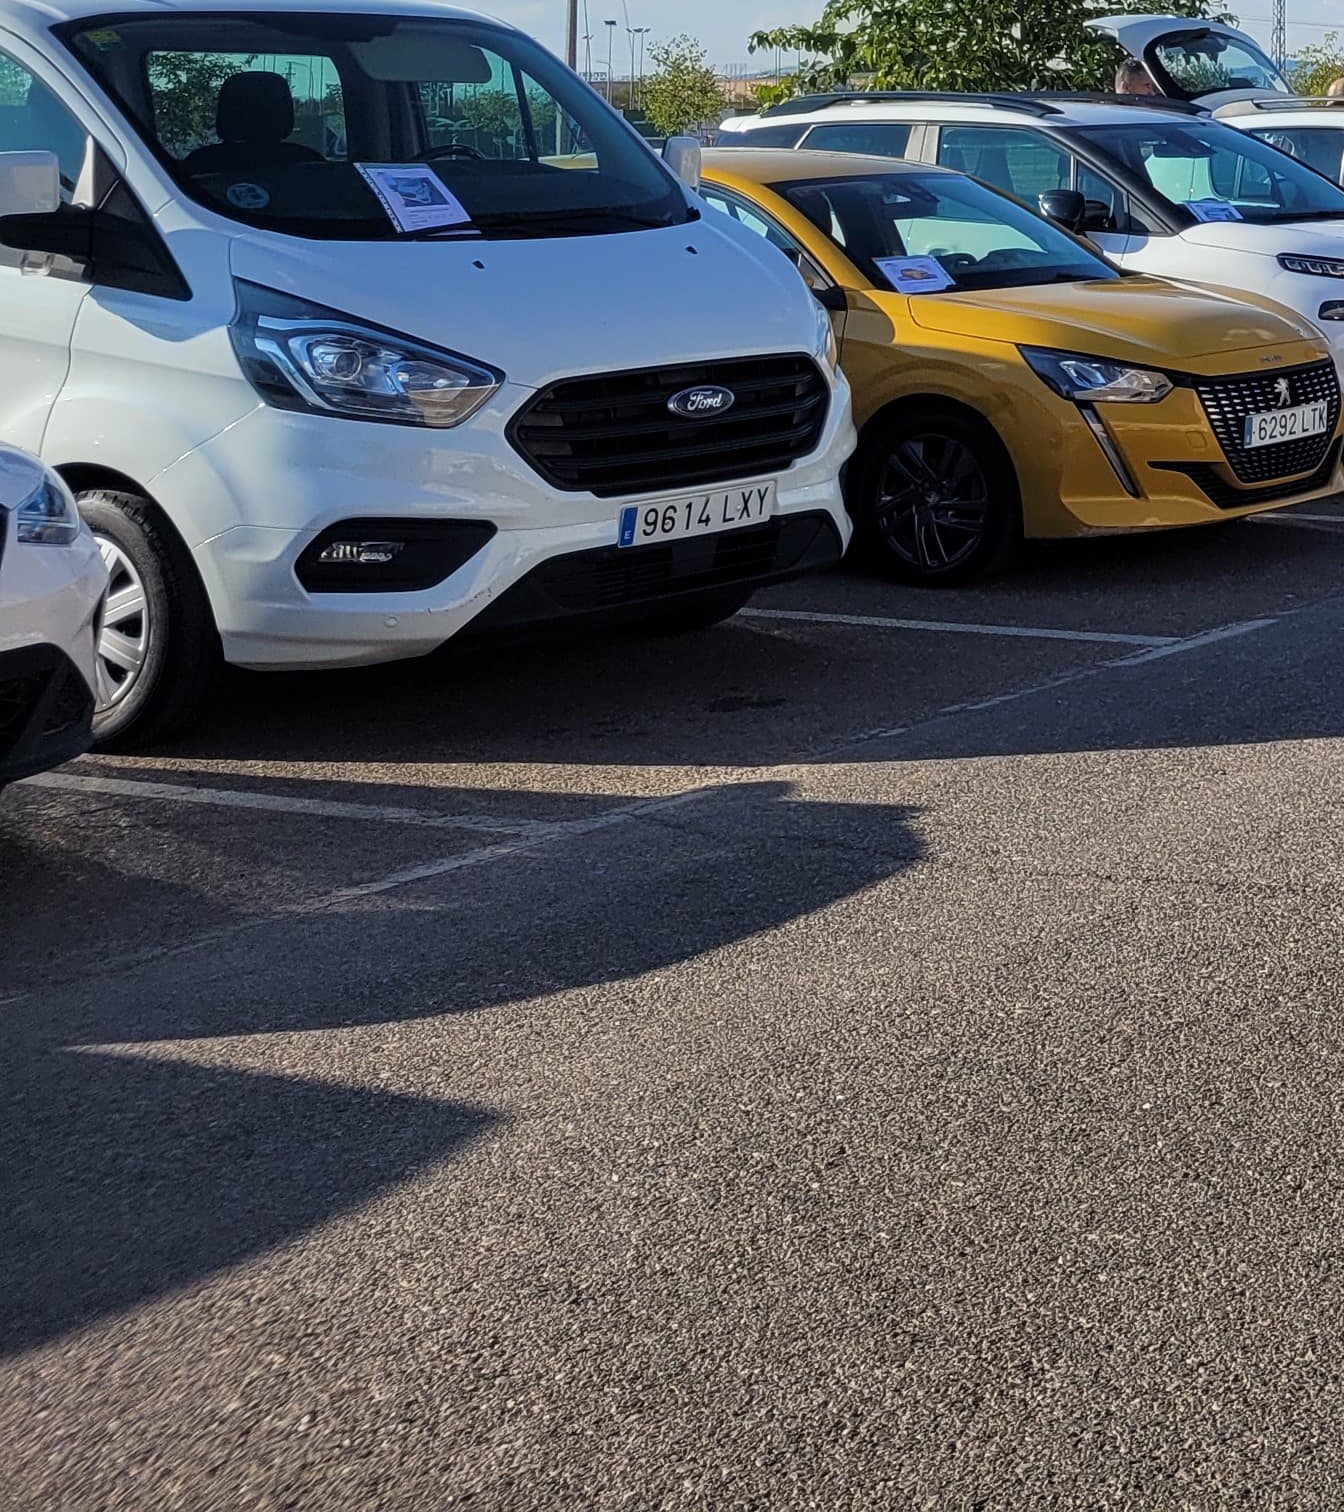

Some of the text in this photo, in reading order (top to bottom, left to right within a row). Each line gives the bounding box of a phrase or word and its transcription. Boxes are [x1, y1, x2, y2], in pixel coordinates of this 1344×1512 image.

[687, 390, 722, 411] Ford
[1258, 405, 1326, 441] 6292 LTK
[643, 497, 712, 537] 9614
[722, 487, 769, 524] LXY
